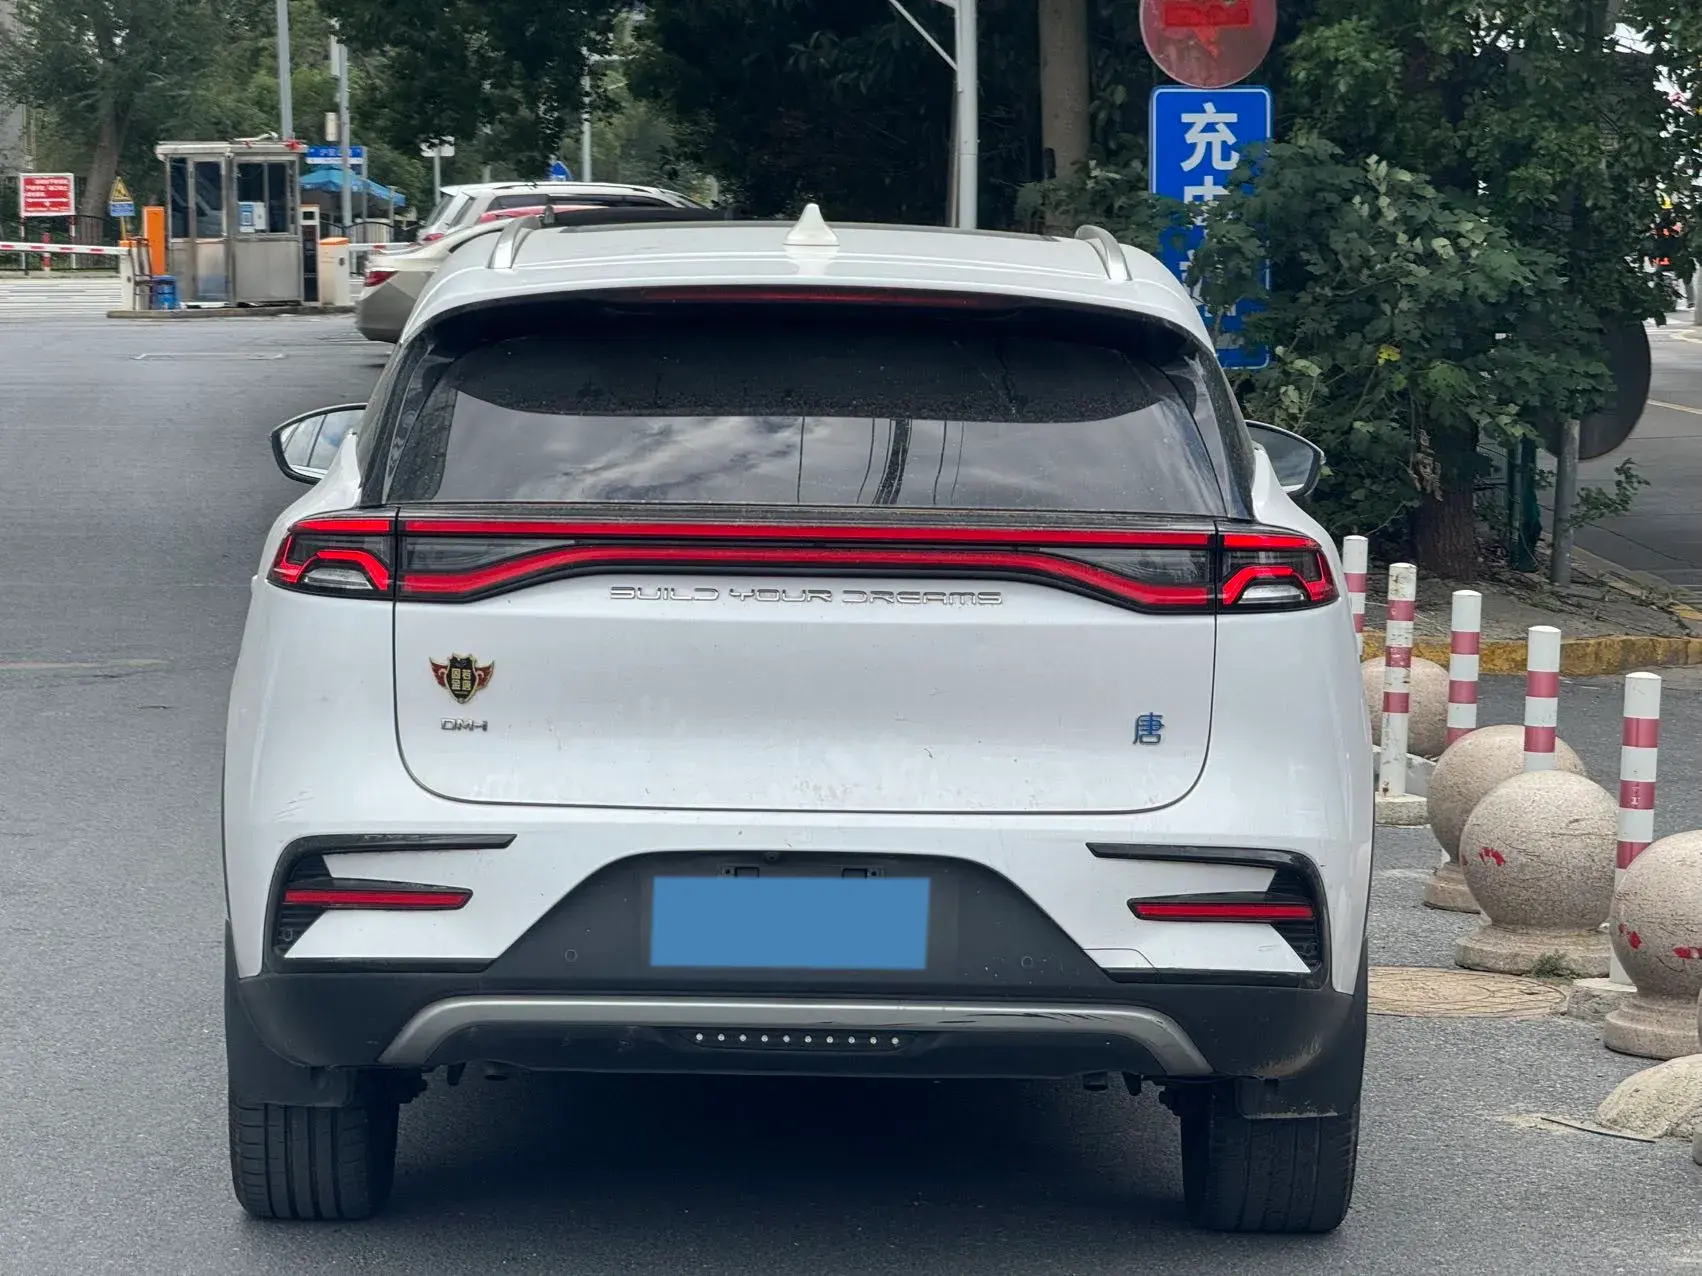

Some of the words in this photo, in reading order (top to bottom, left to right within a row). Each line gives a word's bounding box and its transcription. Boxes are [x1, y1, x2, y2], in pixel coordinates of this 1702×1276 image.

[610, 586, 720, 601] BUILD
[729, 588, 833, 603] YOUR
[842, 589, 1003, 605] DREAMS
[1132, 711, 1165, 746] 唐
